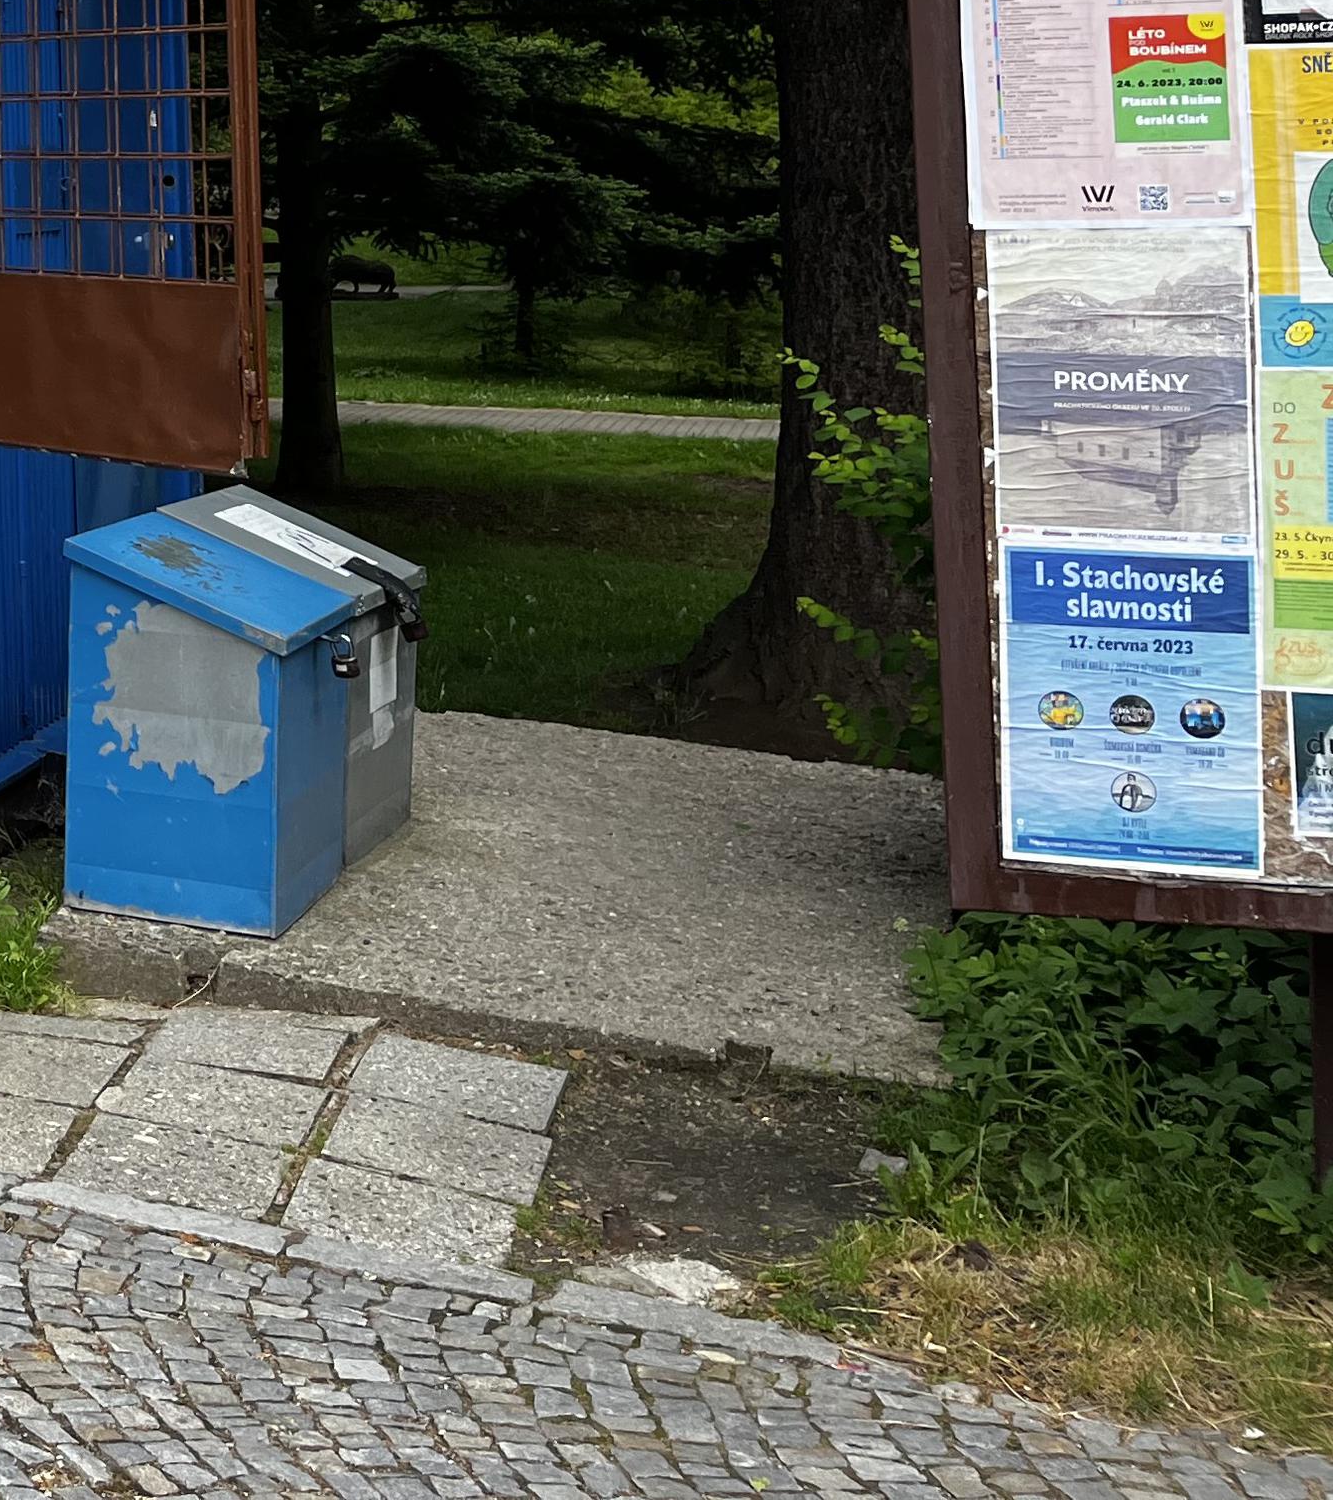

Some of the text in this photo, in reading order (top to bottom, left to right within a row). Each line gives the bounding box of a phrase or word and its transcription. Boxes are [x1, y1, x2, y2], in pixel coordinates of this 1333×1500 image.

[1128, 26, 1166, 39] LÉTO
[1129, 41, 1207, 56] BOUBÍNEM
[1189, 77, 1223, 87] 20:00
[1177, 113, 1208, 125] Clark
[1054, 369, 1190, 393] PROMĚNY
[1273, 402, 1296, 414] DO
[1272, 423, 1289, 444] Z
[1275, 459, 1294, 480] U
[1275, 490, 1290, 516] Š
[1275, 550, 1292, 560] 29.
[1035, 561, 1225, 595] I. Stachovské
[1067, 592, 1192, 623] slavnosti
[1069, 635, 1193, 655] 17. června 2023
